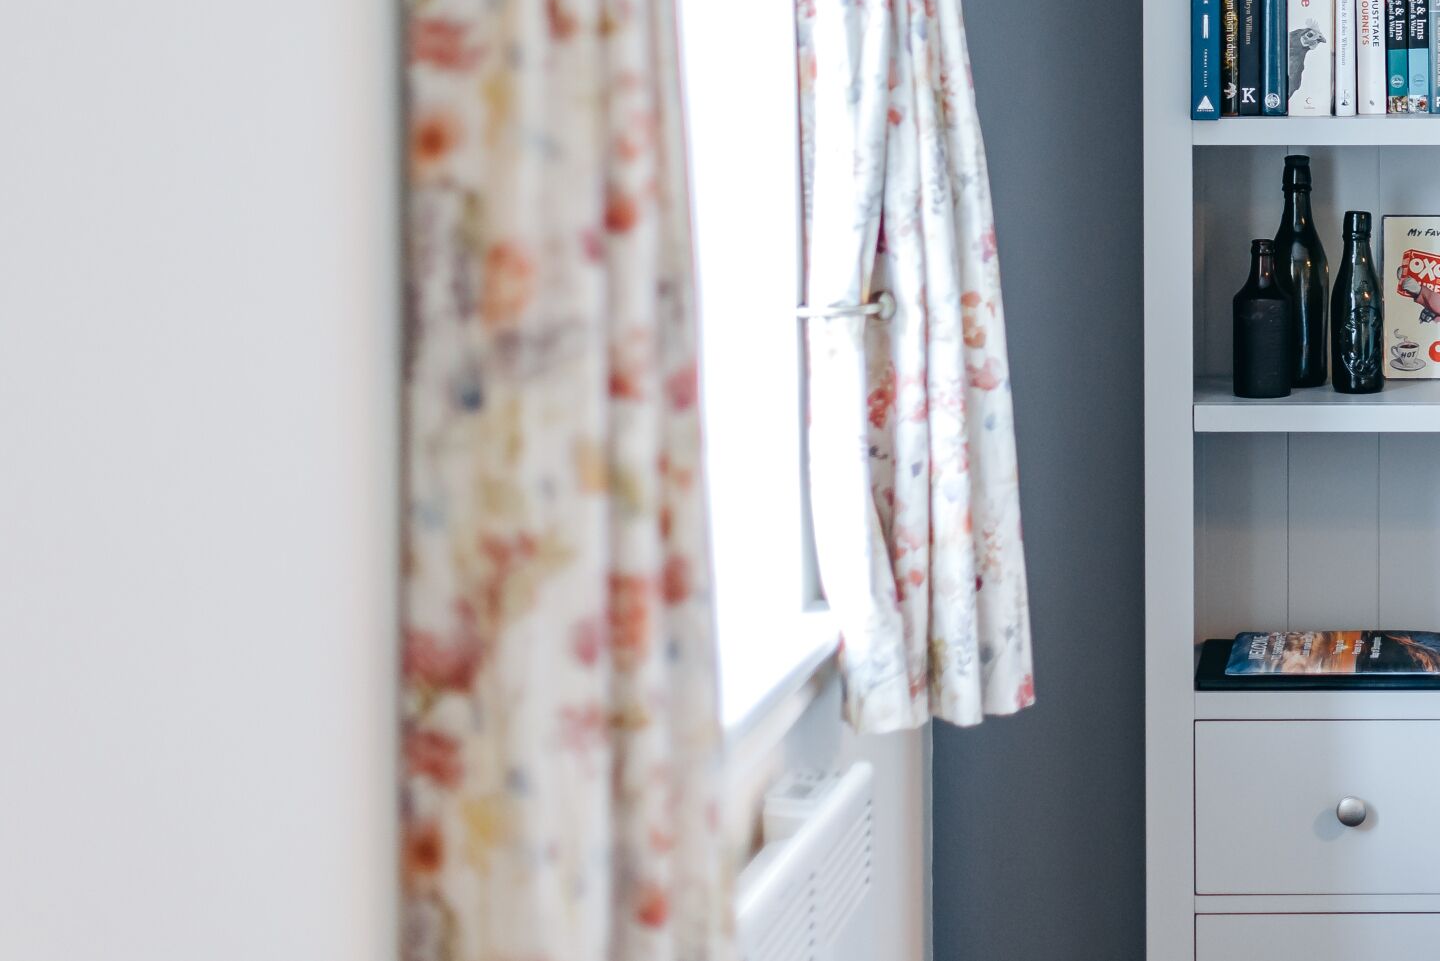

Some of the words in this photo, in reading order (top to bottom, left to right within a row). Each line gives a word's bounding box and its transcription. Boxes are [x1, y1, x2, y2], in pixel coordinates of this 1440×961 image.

[1396, 8, 1404, 16] &
[1417, 6, 1426, 14] &
[1226, 12, 1236, 33] dawn
[1396, 20, 1405, 40] Inns
[1417, 19, 1426, 40] Inns
[1226, 34, 1235, 42] to
[1226, 43, 1236, 62] dusk
[1242, 88, 1256, 103] K
[1400, 351, 1416, 359] HOT
